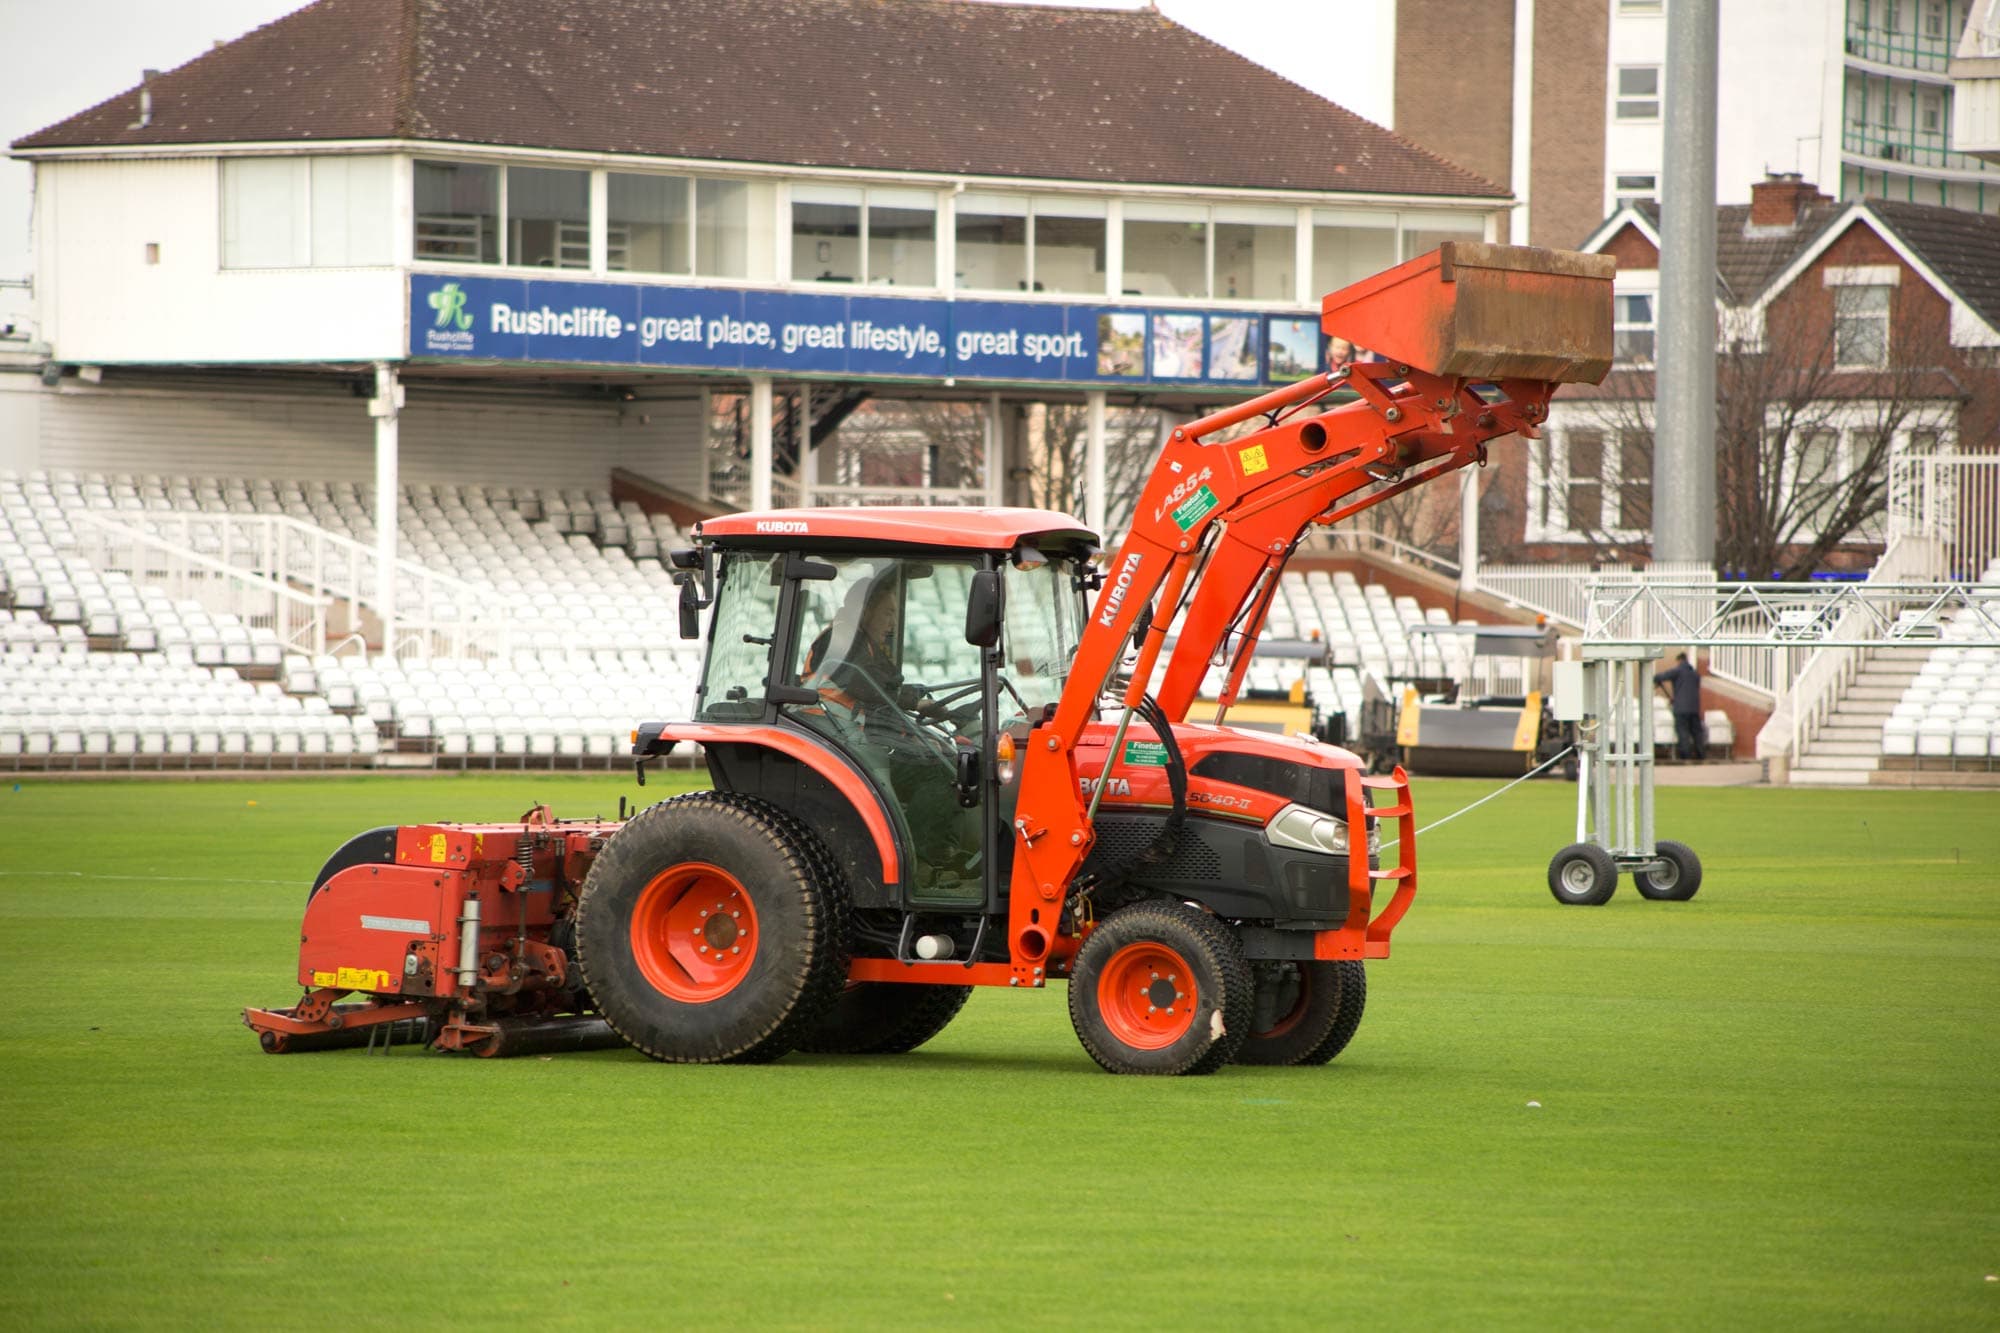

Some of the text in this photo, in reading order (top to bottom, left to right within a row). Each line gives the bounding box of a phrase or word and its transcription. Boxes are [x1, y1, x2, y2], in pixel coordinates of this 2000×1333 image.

[491, 303, 621, 338] Rushcliffe
[641, 315, 703, 346] great
[707, 315, 776, 349] place,
[782, 321, 844, 352] great
[850, 321, 946, 358] lifestyle,
[956, 329, 1018, 360] great
[1023, 331, 1089, 362] sport.
[1155, 467, 1213, 522] LA854
[756, 521, 809, 533] KUBOTA
[1100, 553, 1143, 627] KUBOTA
[1133, 741, 1164, 751] Fineturf
[1079, 777, 1131, 796] BTA
